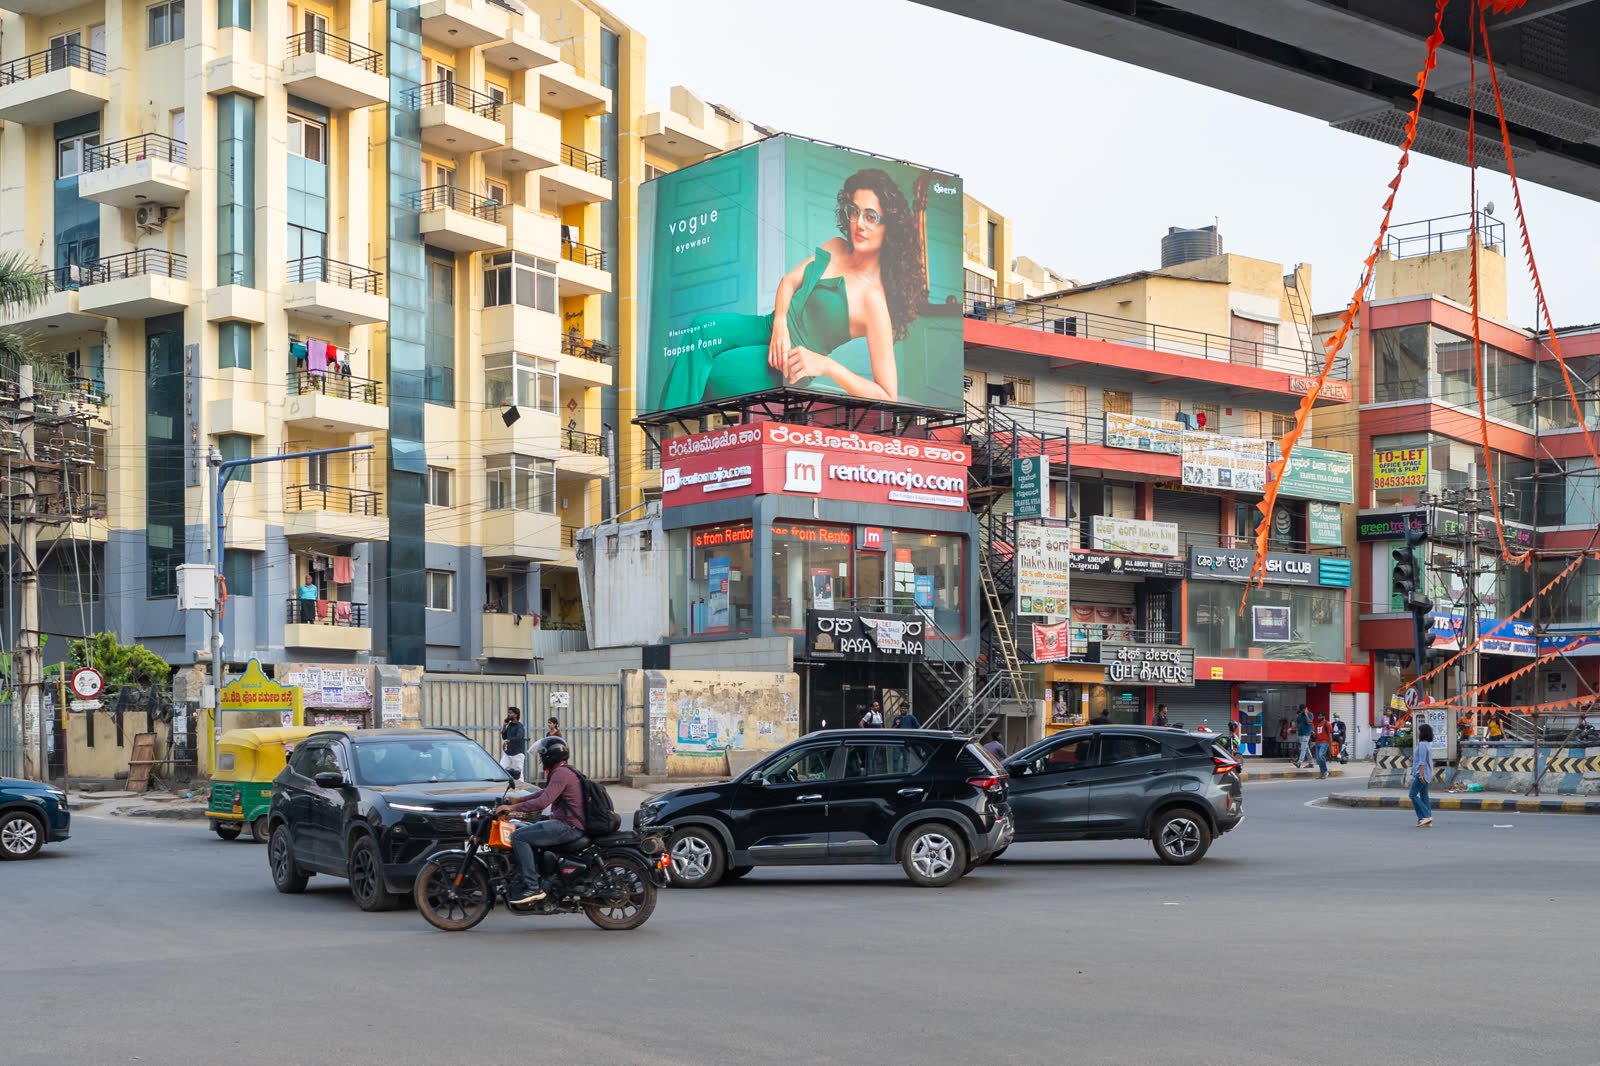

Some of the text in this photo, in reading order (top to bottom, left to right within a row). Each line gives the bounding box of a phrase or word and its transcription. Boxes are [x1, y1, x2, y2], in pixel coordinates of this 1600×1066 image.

[669, 209, 718, 235] vogue
[675, 236, 710, 253] eyewear
[664, 338, 722, 357] Taapsee Pannu
[1377, 448, 1425, 463] TO-LET
[680, 465, 752, 486] rentomojo.com
[828, 463, 964, 492] rentomojo.com
[1299, 471, 1344, 484] TRAVEL VISA GLOBAL
[1375, 474, 1426, 488] 9845334337
[1015, 499, 1031, 507] TRAVEL
[1020, 504, 1037, 513] GLOBAL
[1311, 521, 1329, 529] TRAVEL
[1361, 522, 1389, 536] green
[1390, 517, 1423, 531] treds
[703, 532, 723, 546] from
[818, 528, 851, 543] Rento
[1139, 527, 1176, 542] Bakes King
[1318, 529, 1337, 537] GLOBAL
[1021, 554, 1046, 570] Bakes
[1048, 556, 1068, 572] King
[1149, 561, 1164, 569] TEETH
[1285, 560, 1312, 574] CLUB
[1434, 617, 1450, 629] TVS
[840, 637, 872, 654] RASA
[1429, 711, 1445, 720] PG PG
